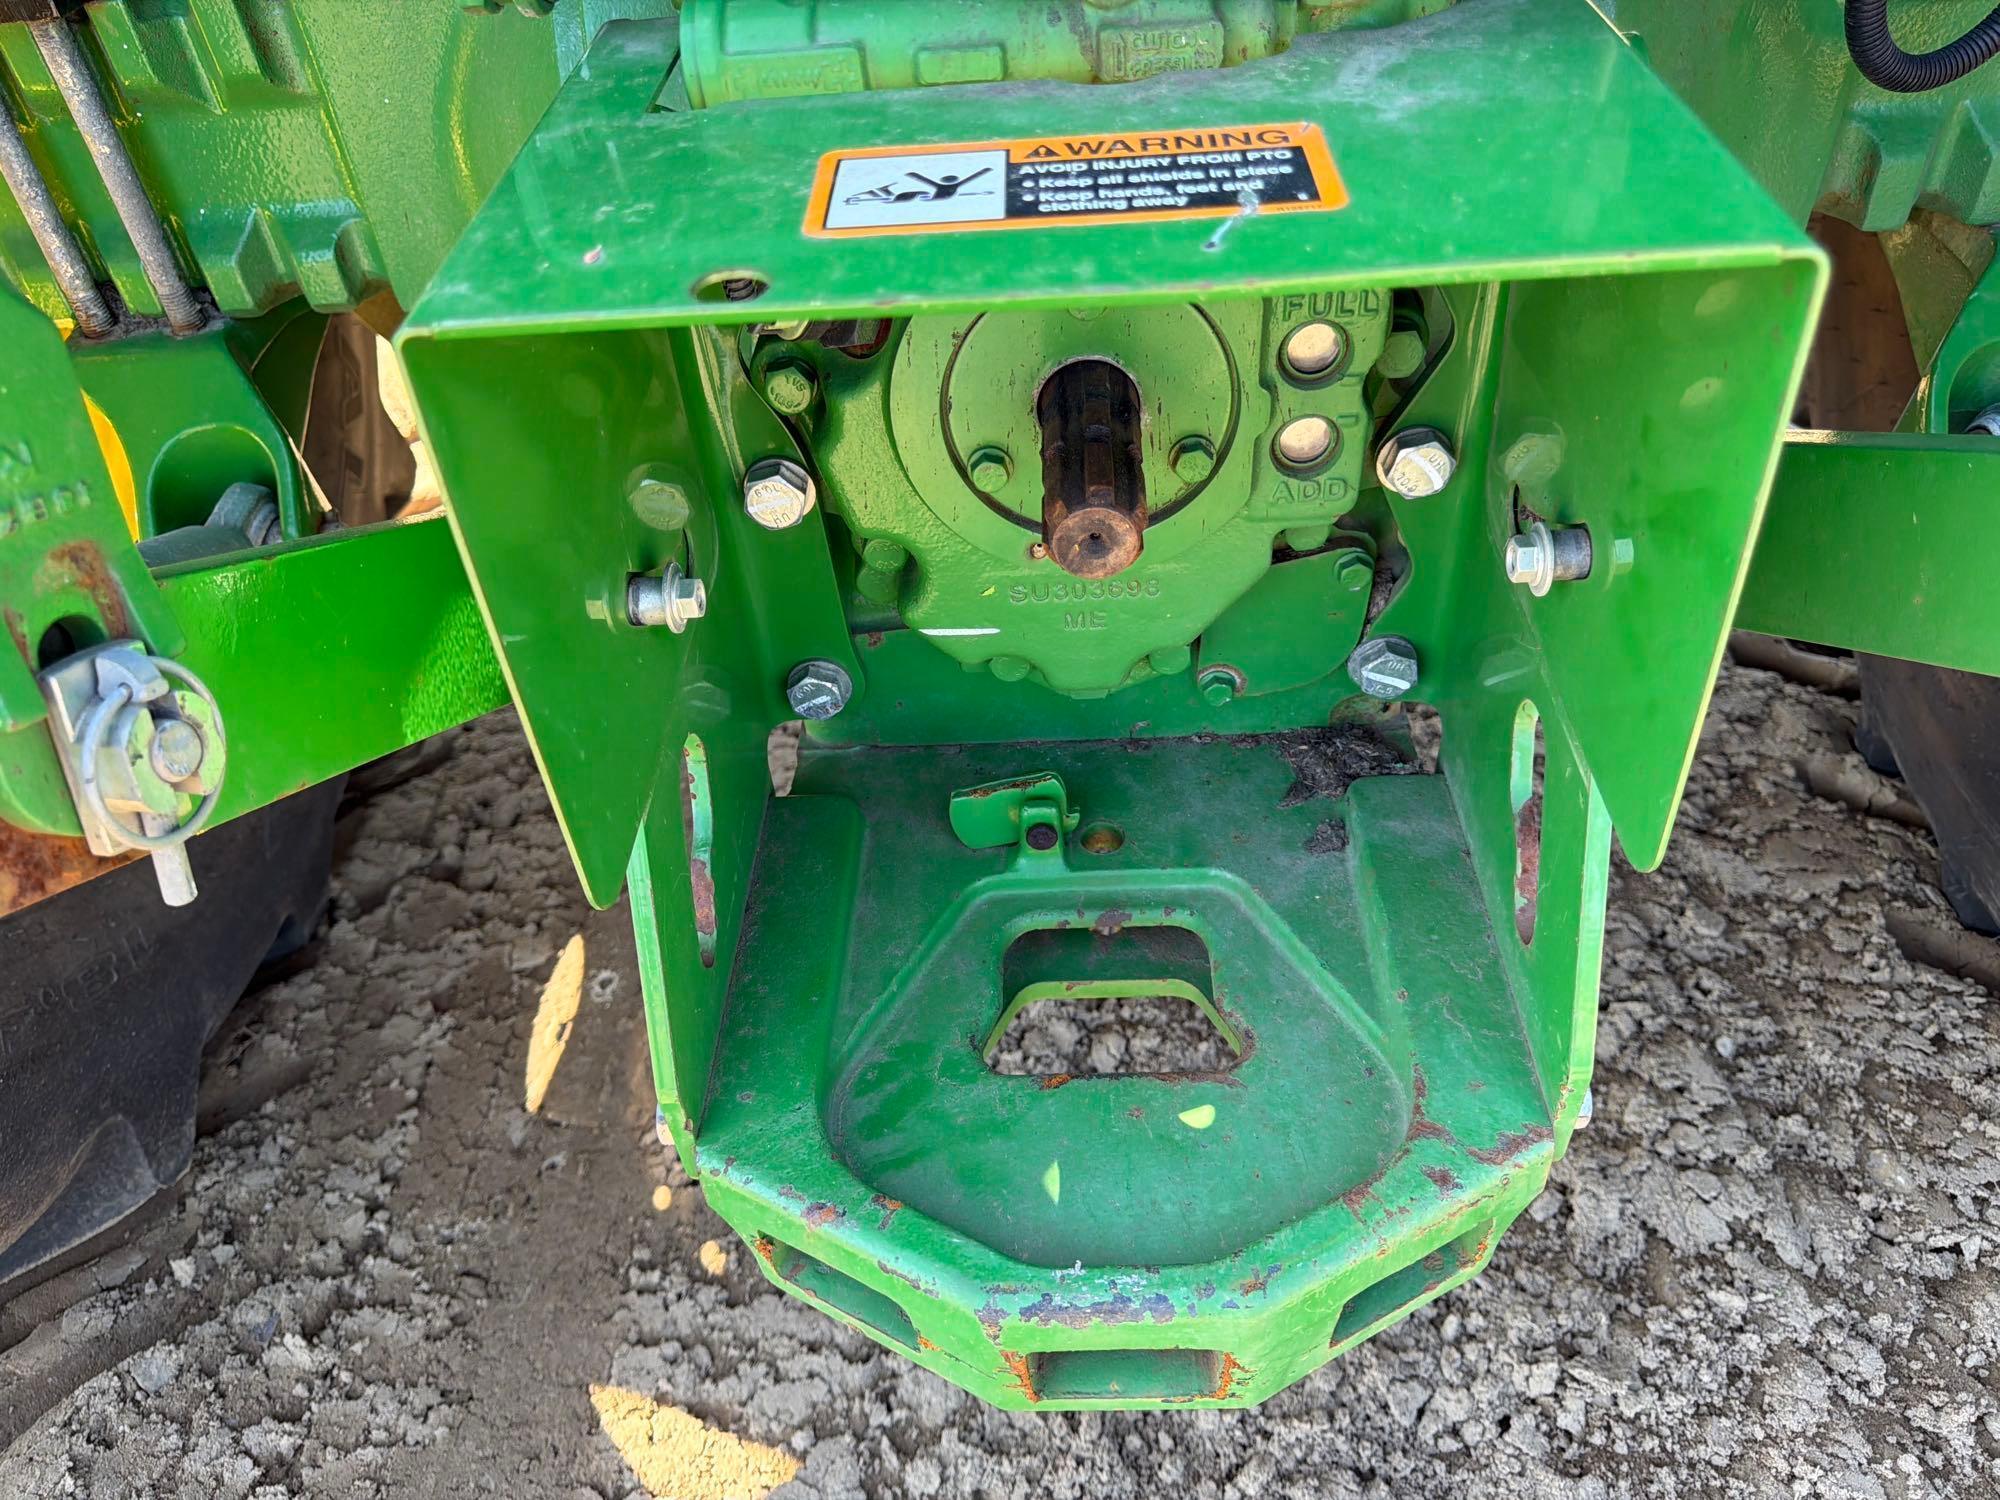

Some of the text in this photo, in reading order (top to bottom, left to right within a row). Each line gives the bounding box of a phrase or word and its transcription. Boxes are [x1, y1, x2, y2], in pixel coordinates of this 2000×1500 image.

[1064, 130, 1290, 156] WARNING
[1019, 149, 1293, 175] AVOID INJURY FROM PTO
[1038, 164, 1293, 188] Keep all shields in place
[1038, 179, 1265, 202] Keep hands, feet and
[1038, 195, 1189, 212] clothing away
[1282, 288, 1380, 321] FULL
[1273, 477, 1349, 501] ADD
[1063, 610, 1107, 630] ME
